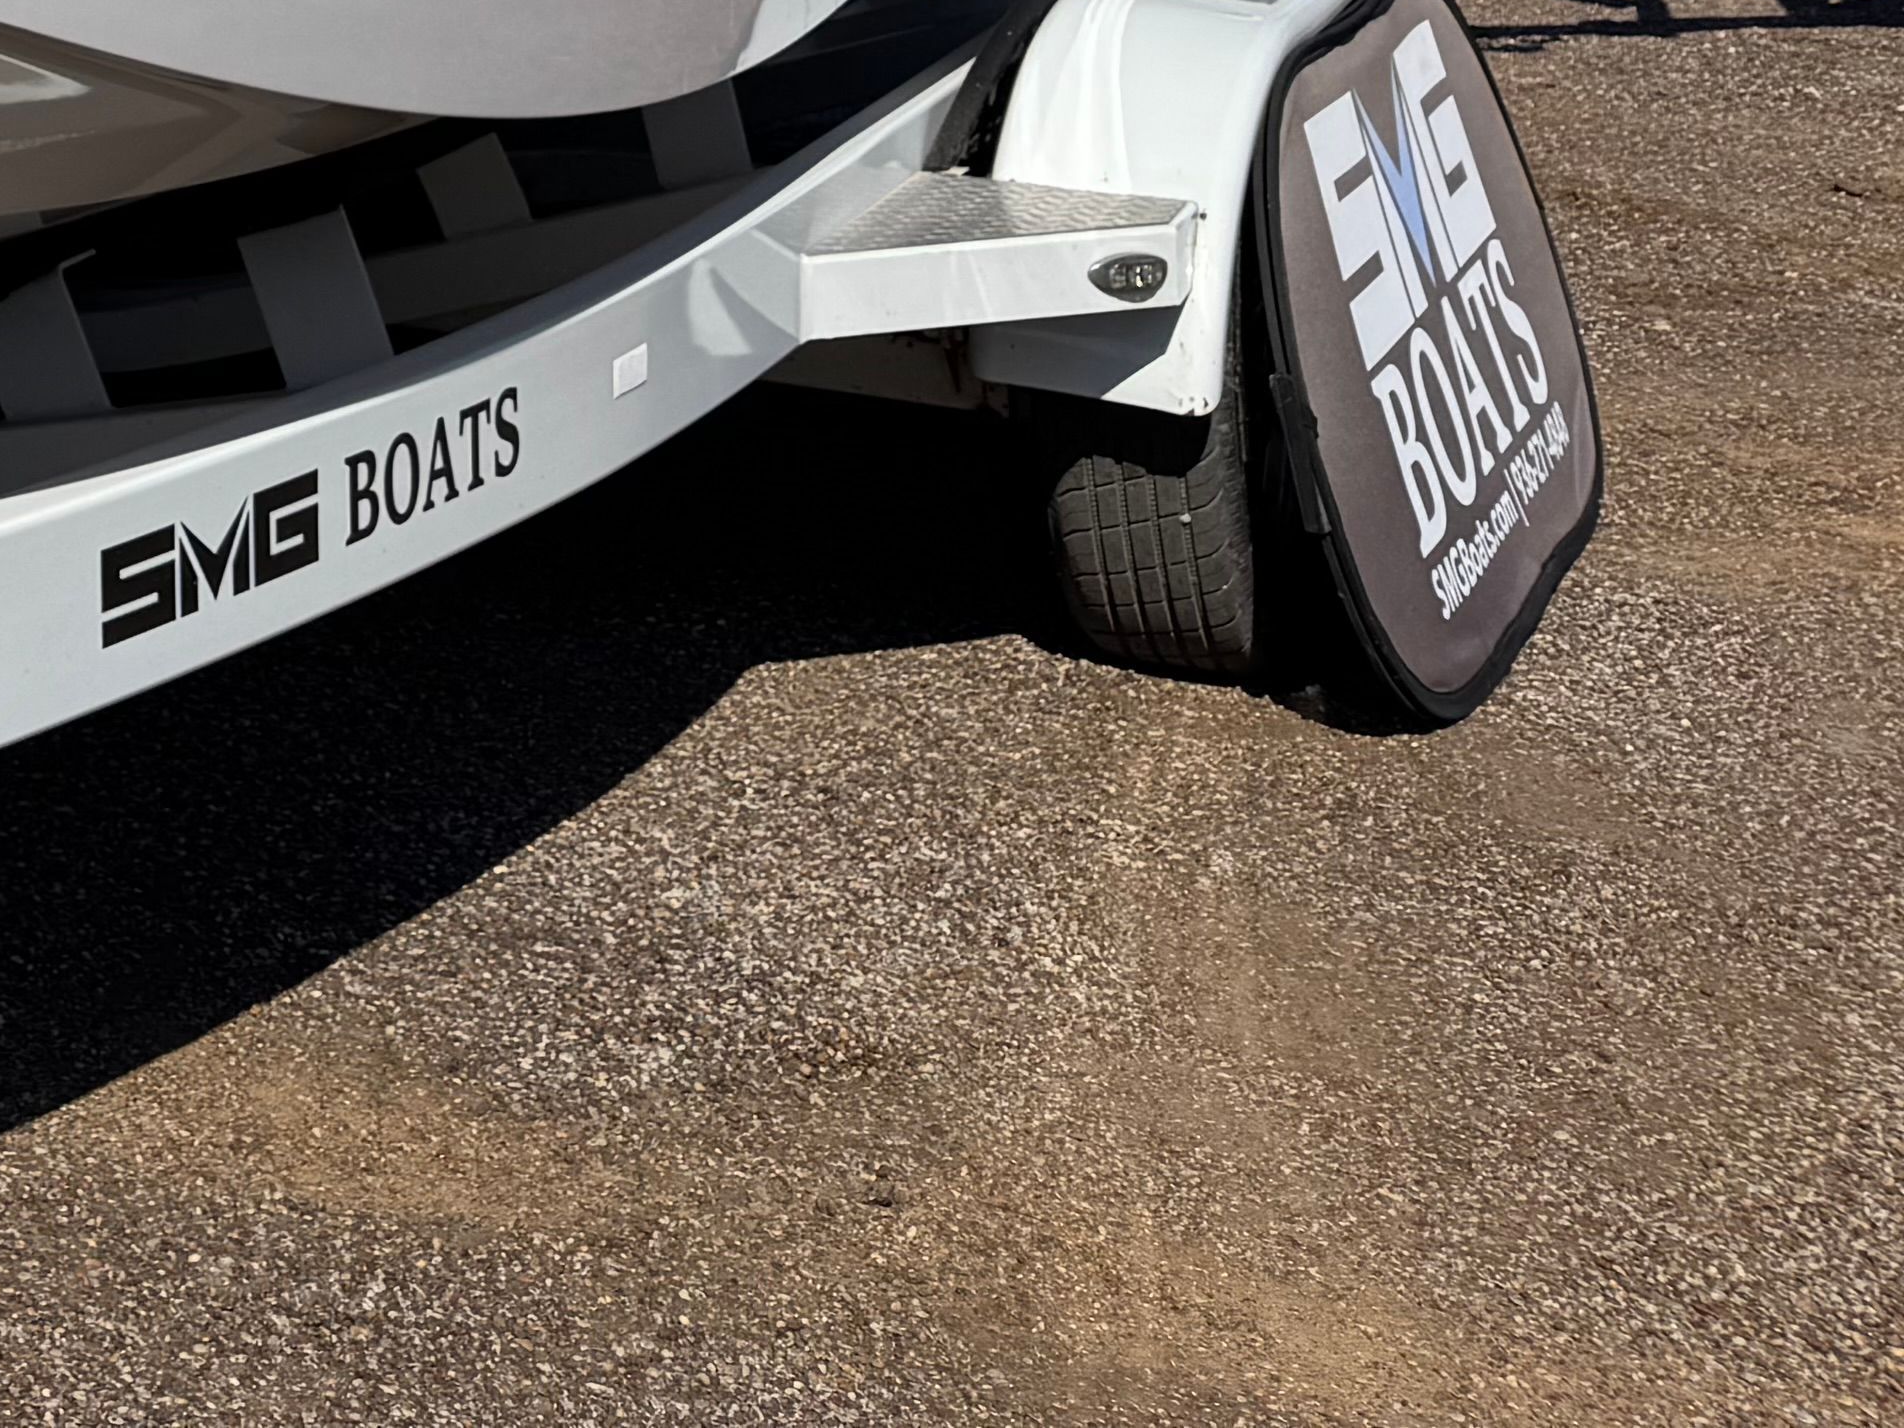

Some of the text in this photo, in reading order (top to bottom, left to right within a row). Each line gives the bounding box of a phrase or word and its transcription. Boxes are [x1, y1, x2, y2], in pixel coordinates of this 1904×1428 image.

[1303, 19, 1496, 372] SMG
[101, 386, 521, 650] SMG BOATS
[1371, 238, 1549, 559] BOATS
